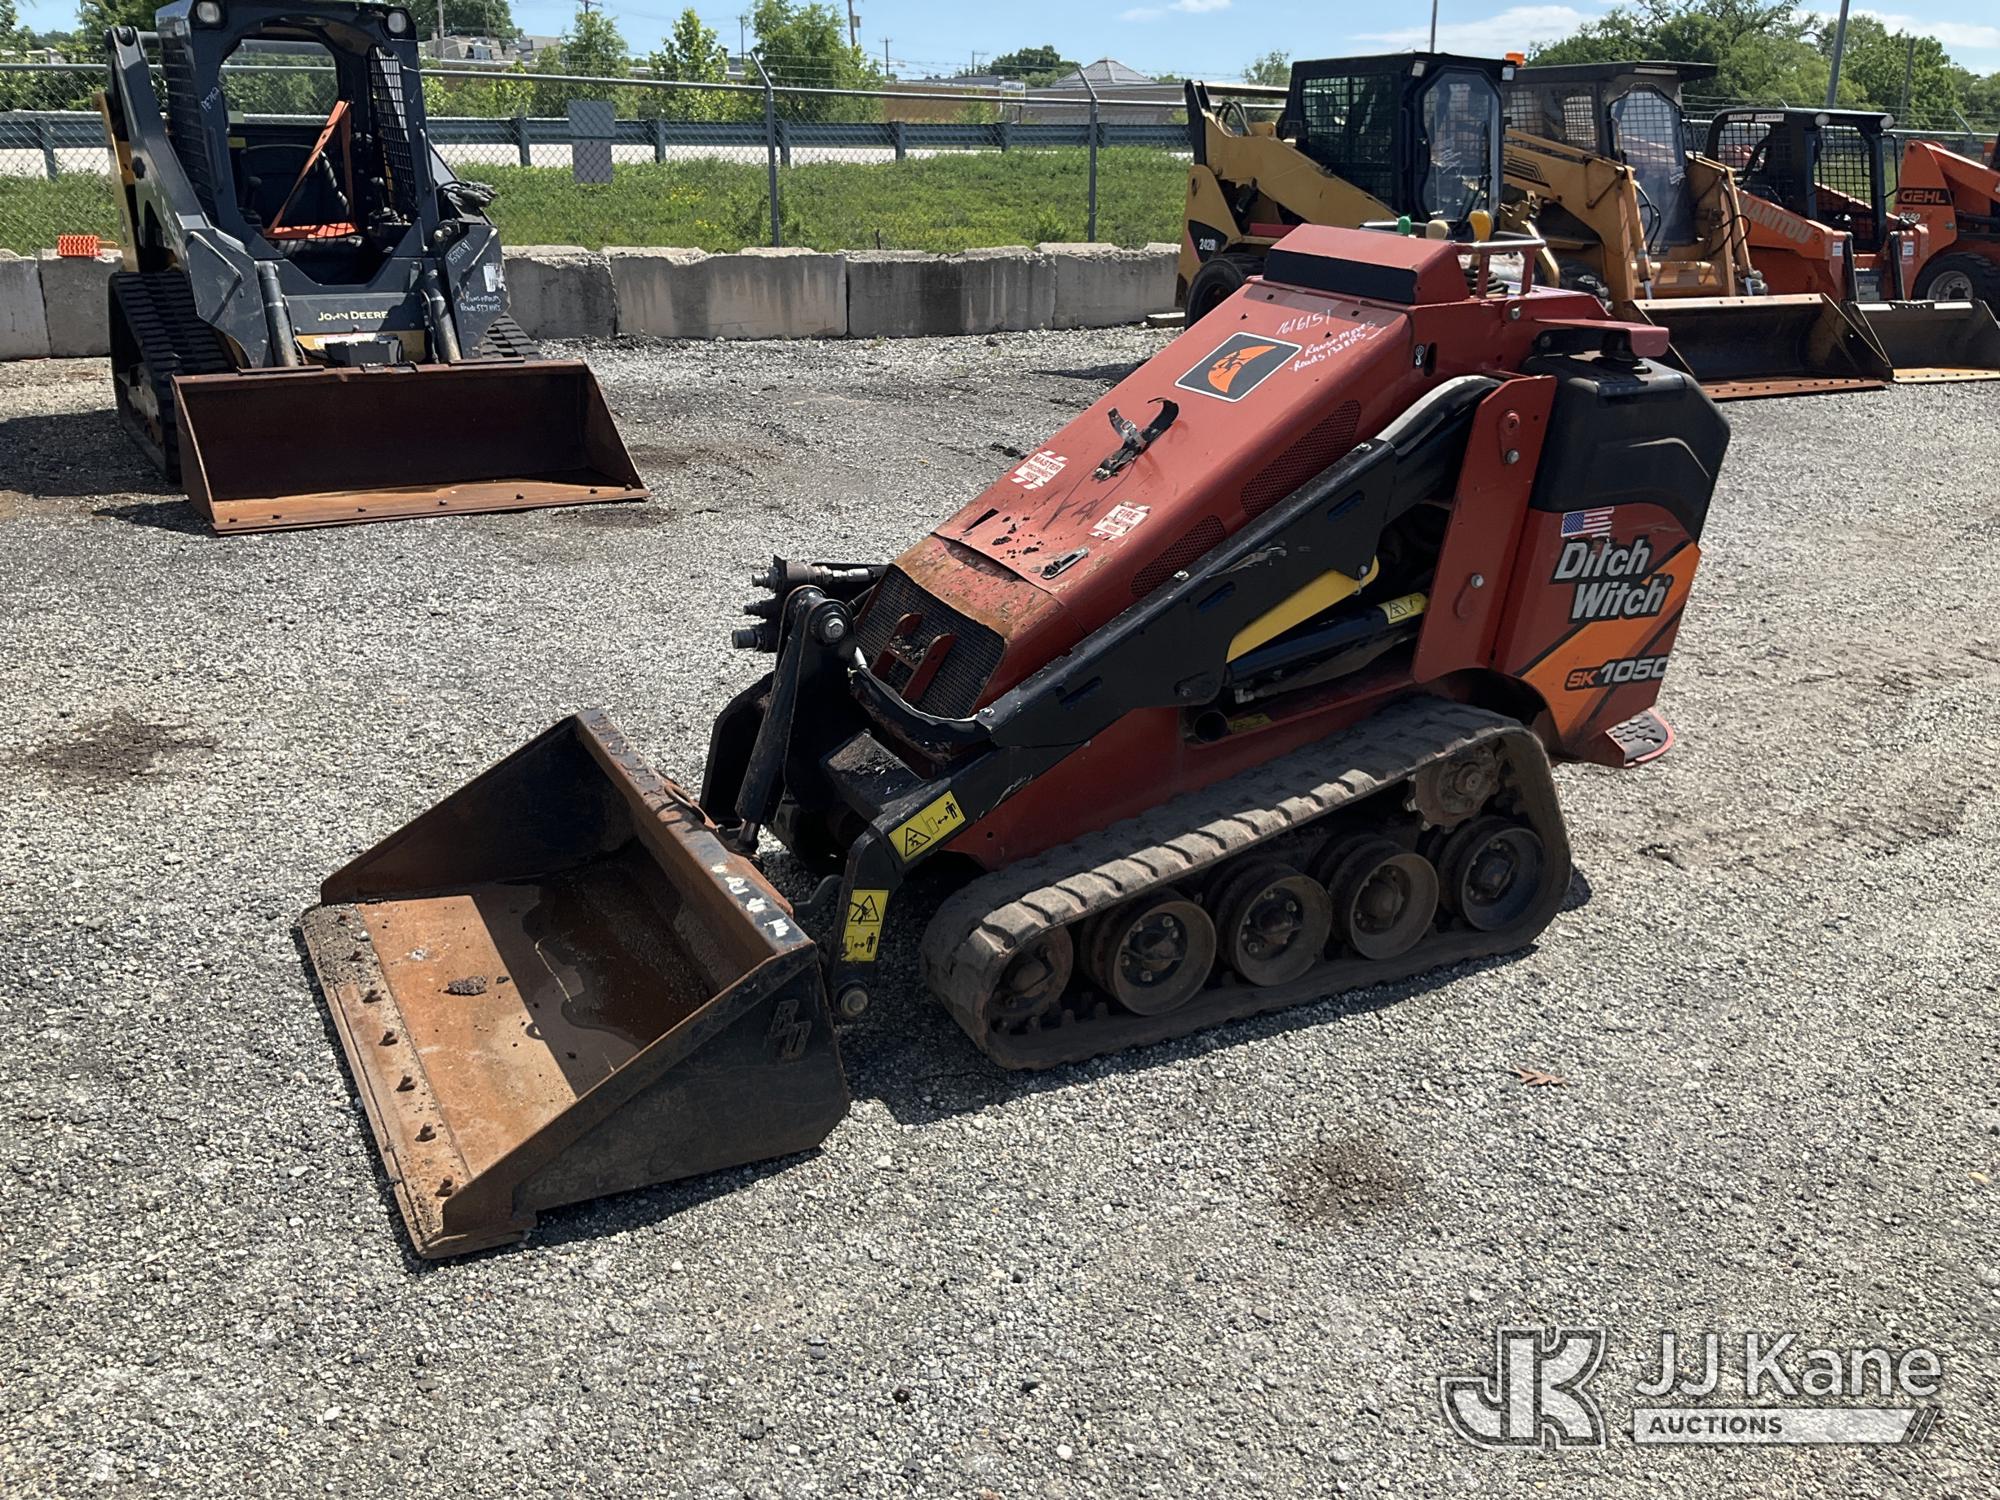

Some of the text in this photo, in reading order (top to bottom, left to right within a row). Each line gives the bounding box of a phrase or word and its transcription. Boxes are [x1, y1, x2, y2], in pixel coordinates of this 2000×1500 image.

[1900, 189, 1946, 204] GEHL
[350, 310, 389, 320] DEERE
[1033, 455, 1061, 472] MASTER
[1117, 508, 1139, 521] FIRE
[1554, 539, 1651, 580] Ditch
[1571, 578, 1667, 620] Witch
